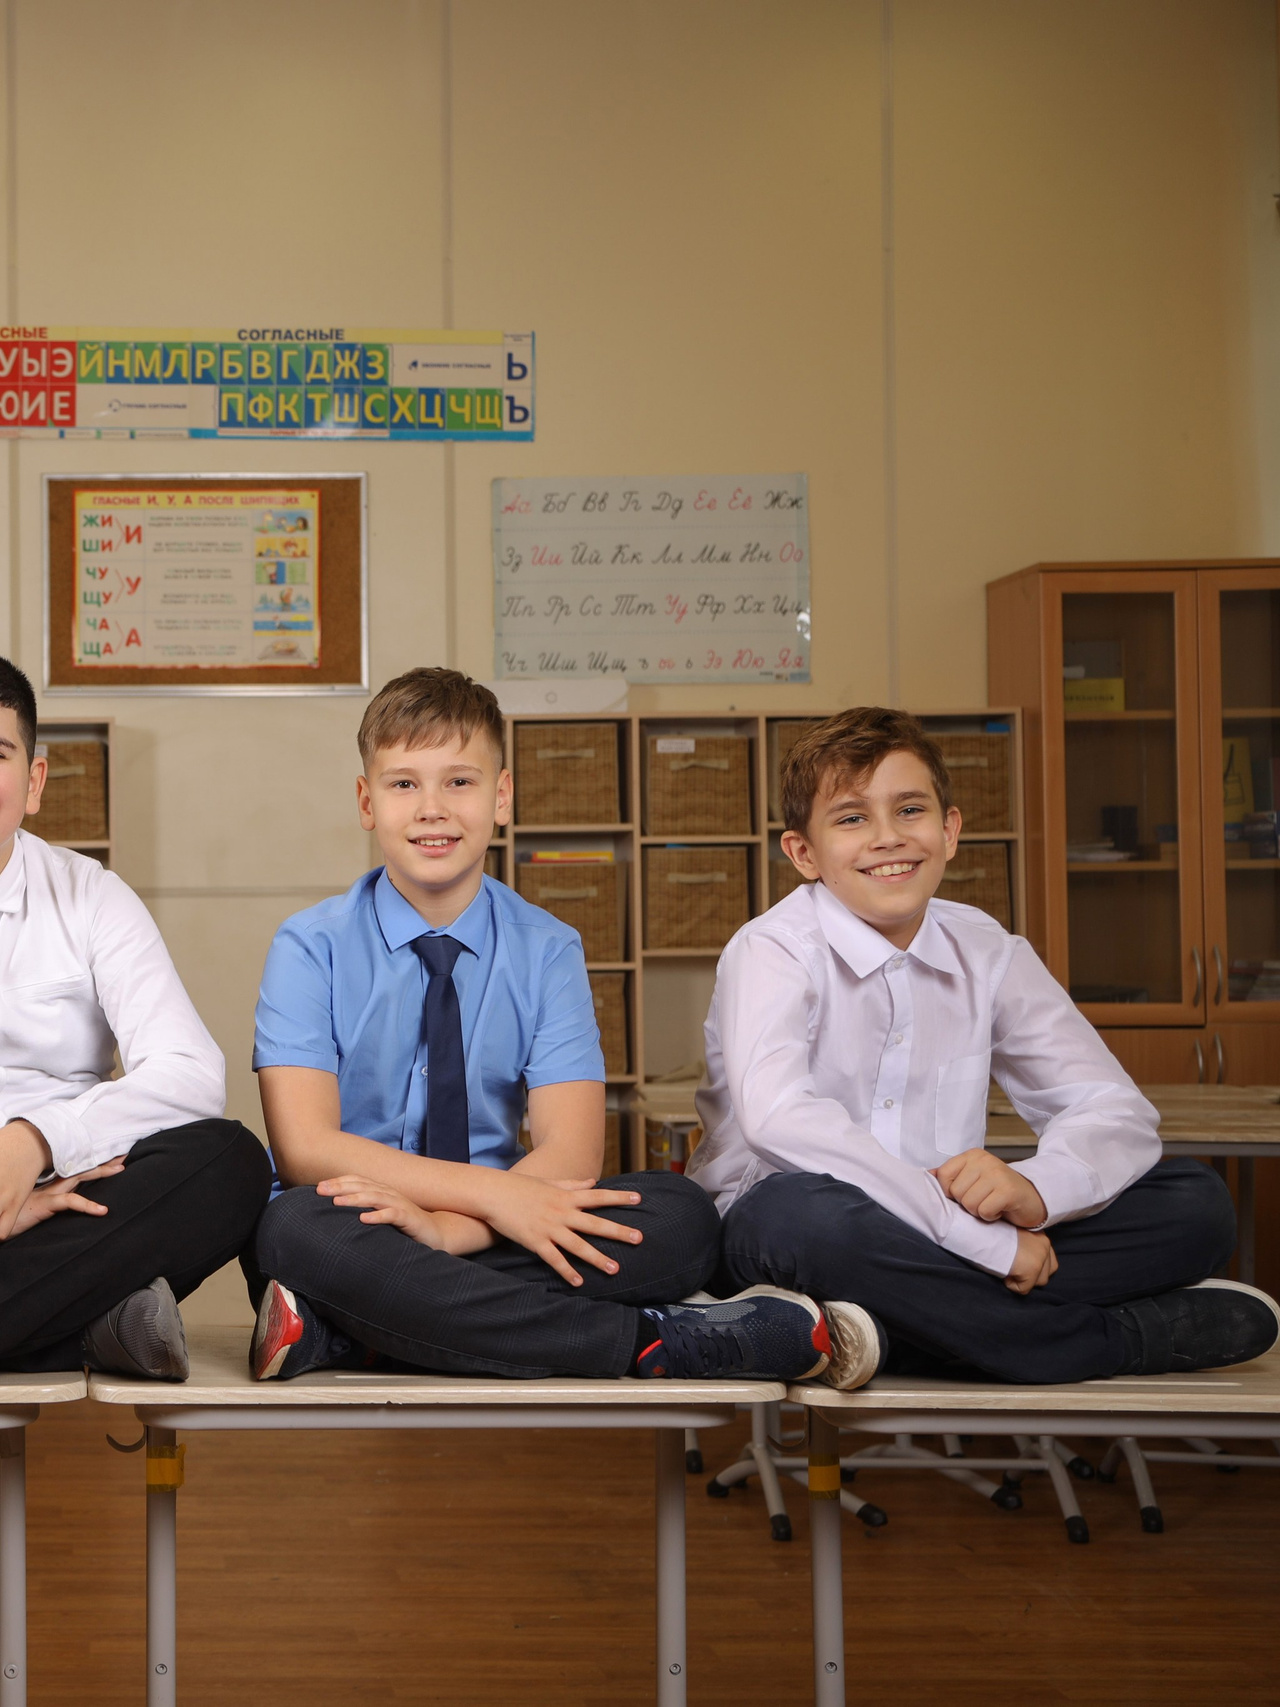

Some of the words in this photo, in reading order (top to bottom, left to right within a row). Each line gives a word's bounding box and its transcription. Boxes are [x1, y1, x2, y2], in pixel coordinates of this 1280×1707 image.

[237, 328, 346, 342] СОГЛАСНЫЕ
[92, 495, 141, 506] ГЛАСНЫЕ
[183, 495, 193, 506] А
[198, 496, 235, 506] ПОСЛЕ
[82, 514, 113, 528] ЖИ
[124, 525, 143, 545] И
[82, 539, 113, 553] ШИ
[85, 566, 109, 581] ЧУ
[124, 576, 142, 596] У
[82, 591, 113, 607] ЩУ
[86, 617, 110, 631] ЧА
[124, 627, 142, 647] А
[82, 642, 114, 658] ЩА
